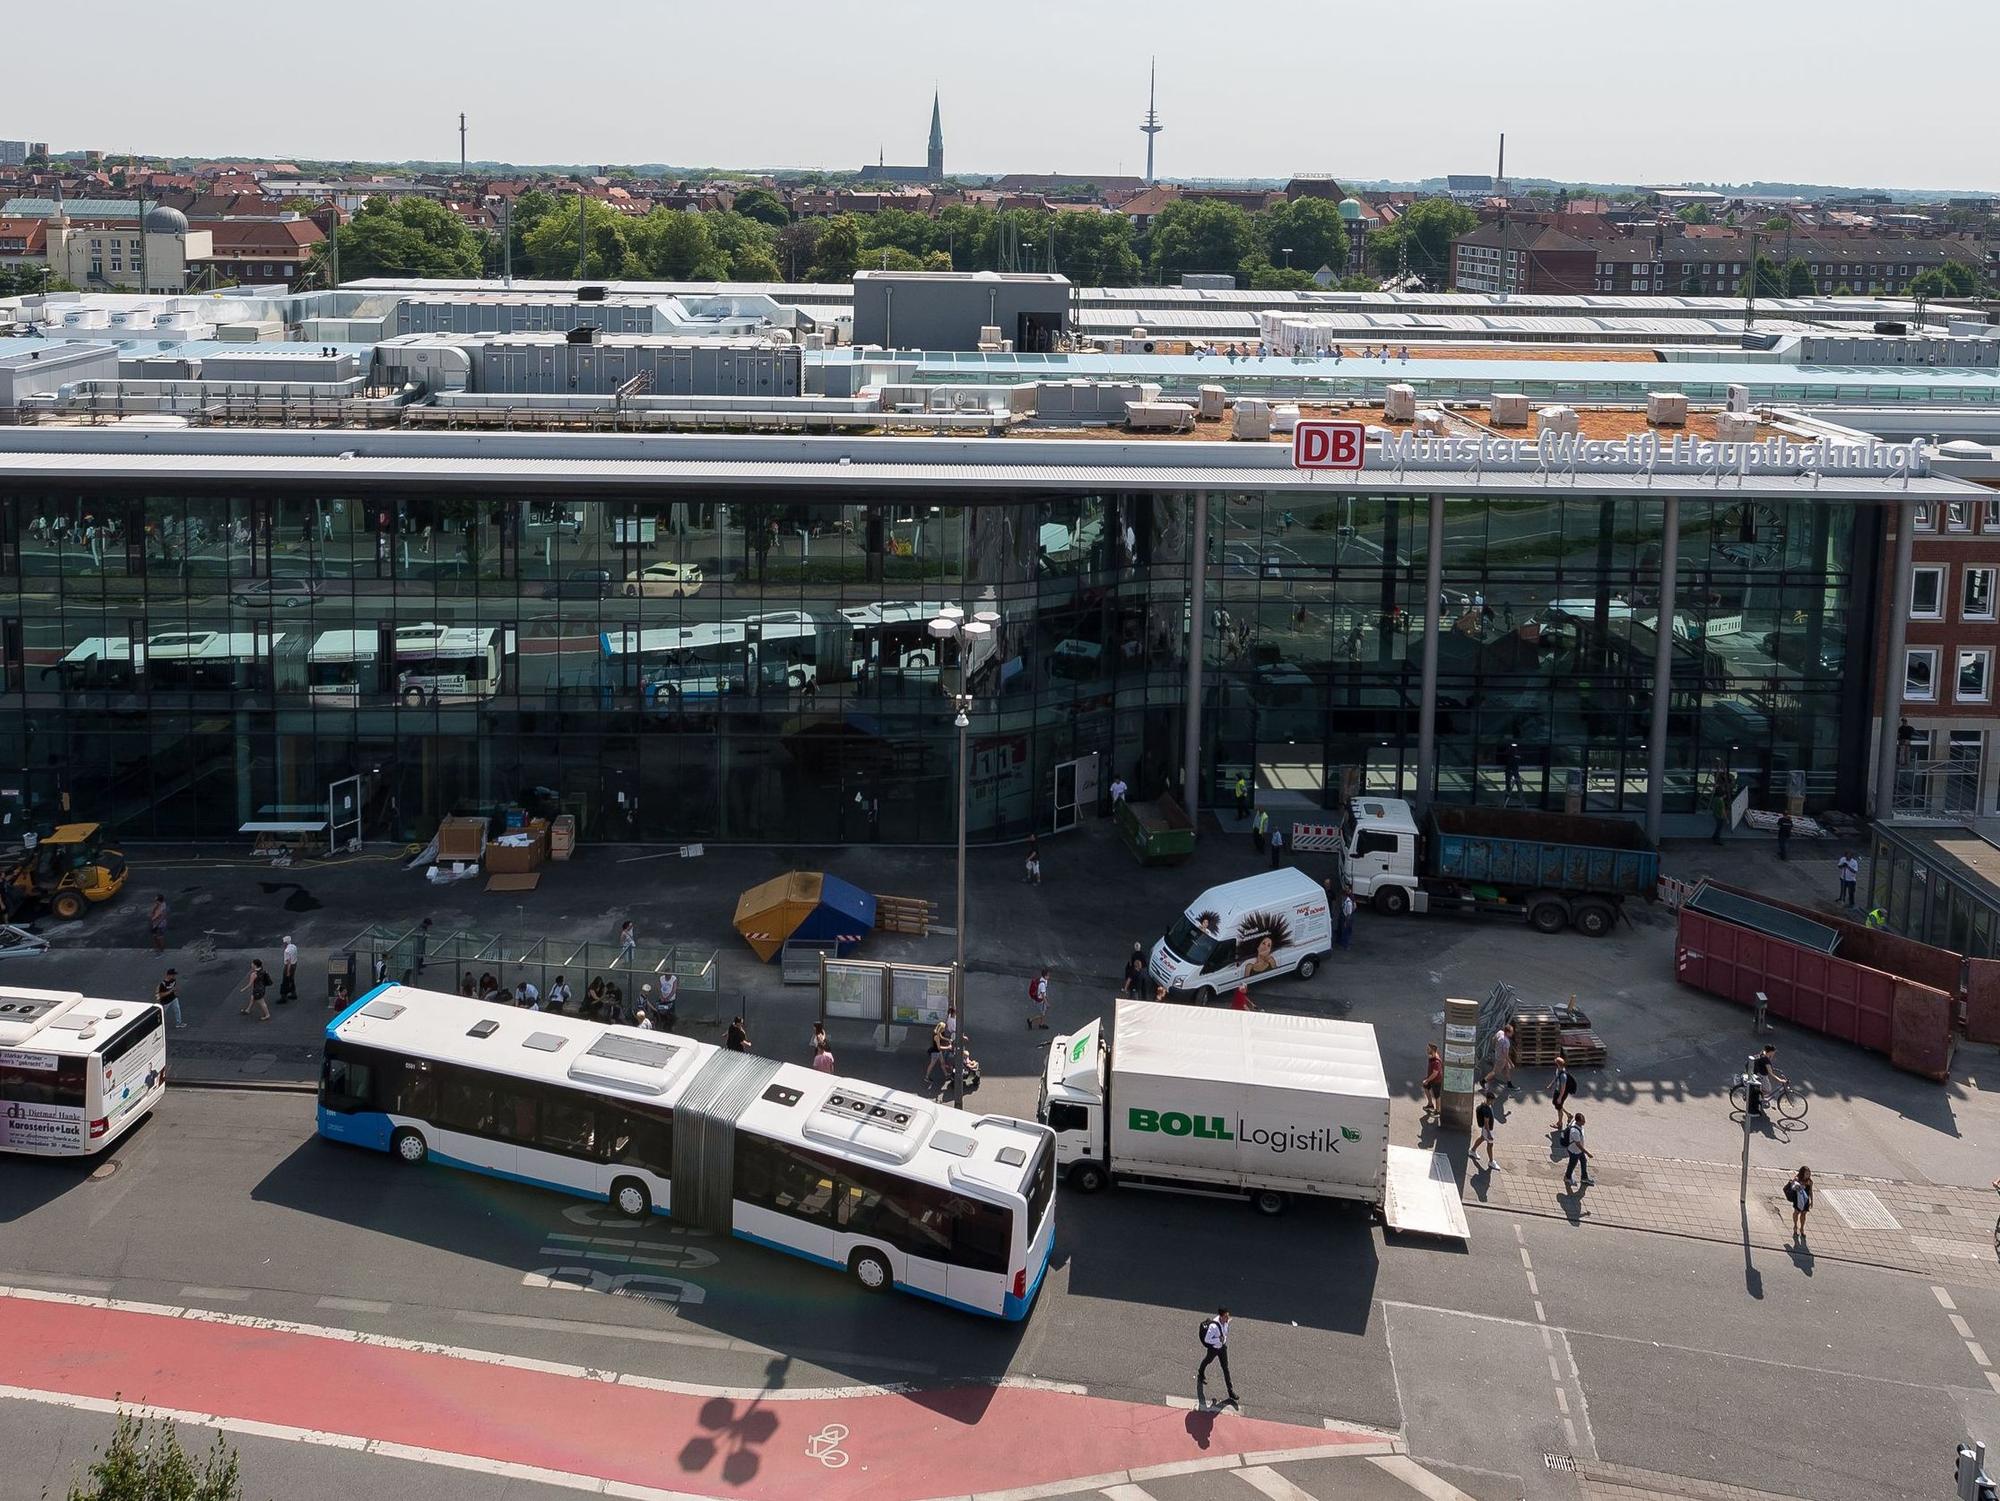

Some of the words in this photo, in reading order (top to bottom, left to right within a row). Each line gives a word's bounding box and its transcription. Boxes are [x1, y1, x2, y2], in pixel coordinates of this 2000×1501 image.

[1302, 428, 1357, 463] DB
[1380, 428, 1529, 465] Münster
[1672, 434, 1926, 475] Hauptbahnhof
[28, 1108, 56, 1119] Dietmar
[1129, 1107, 1234, 1141] BOLL
[1239, 1118, 1341, 1155] Logistik
